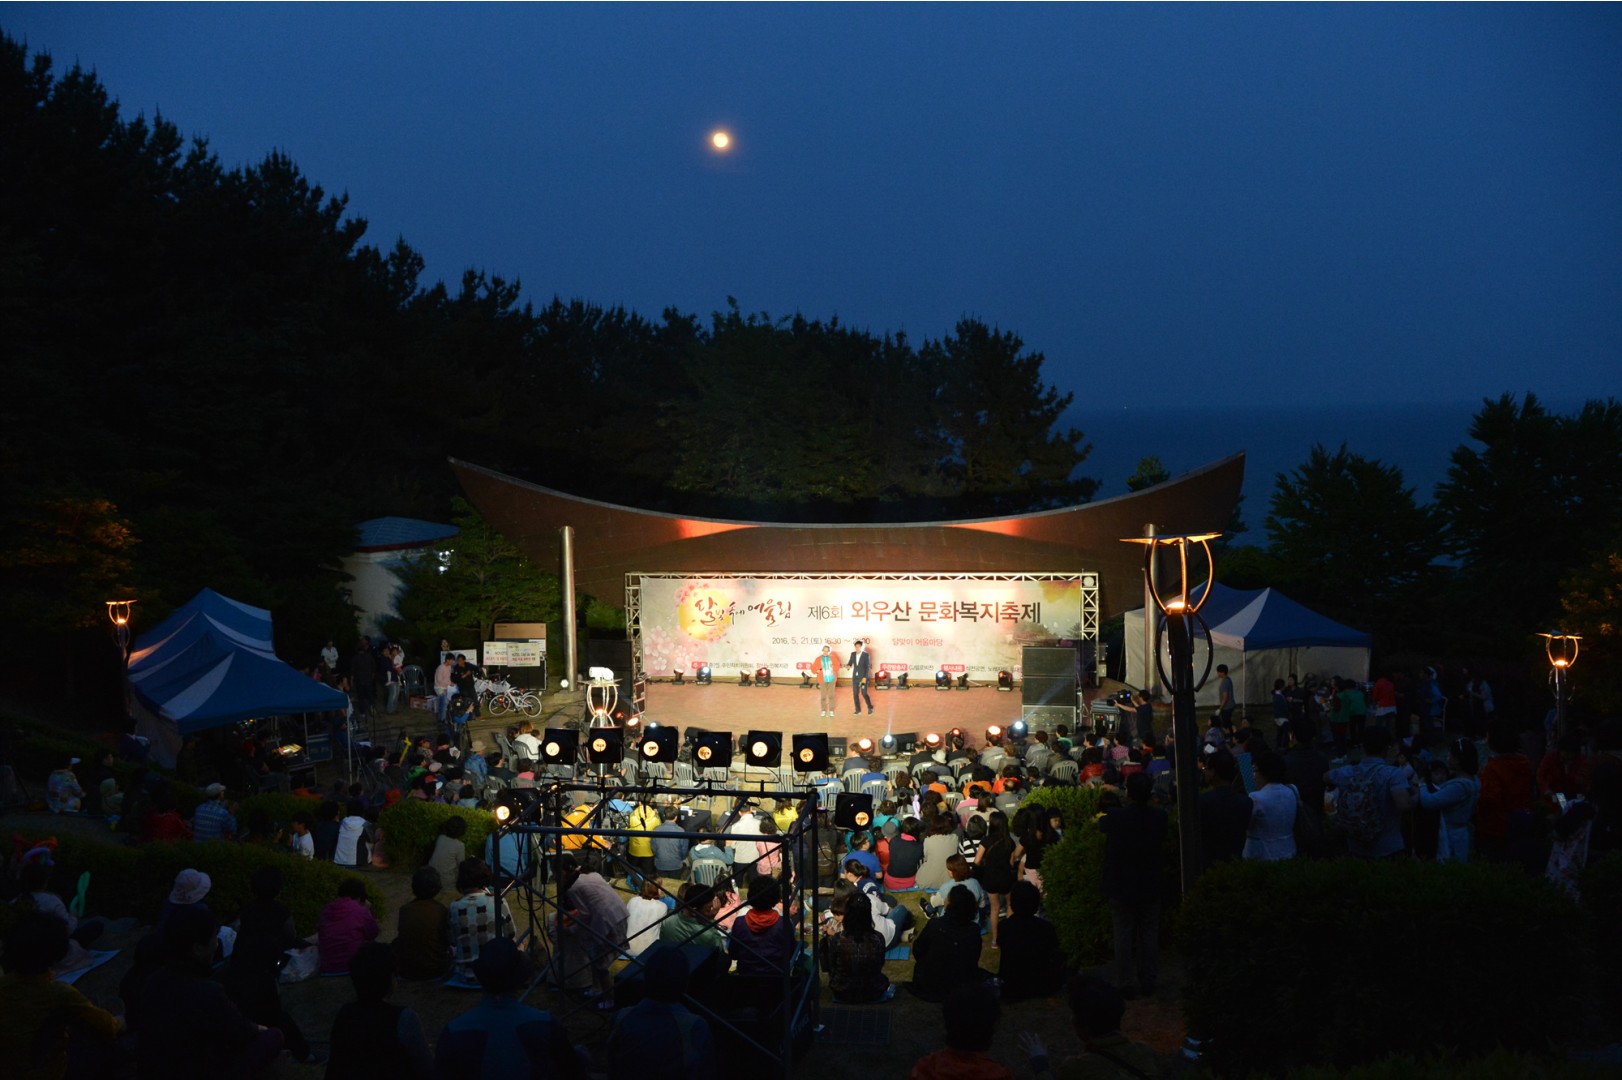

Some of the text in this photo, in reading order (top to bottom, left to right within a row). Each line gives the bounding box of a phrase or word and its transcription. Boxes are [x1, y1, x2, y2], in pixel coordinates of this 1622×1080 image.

[807, 600, 1041, 624] 제6회 와우산 문화복지축제
